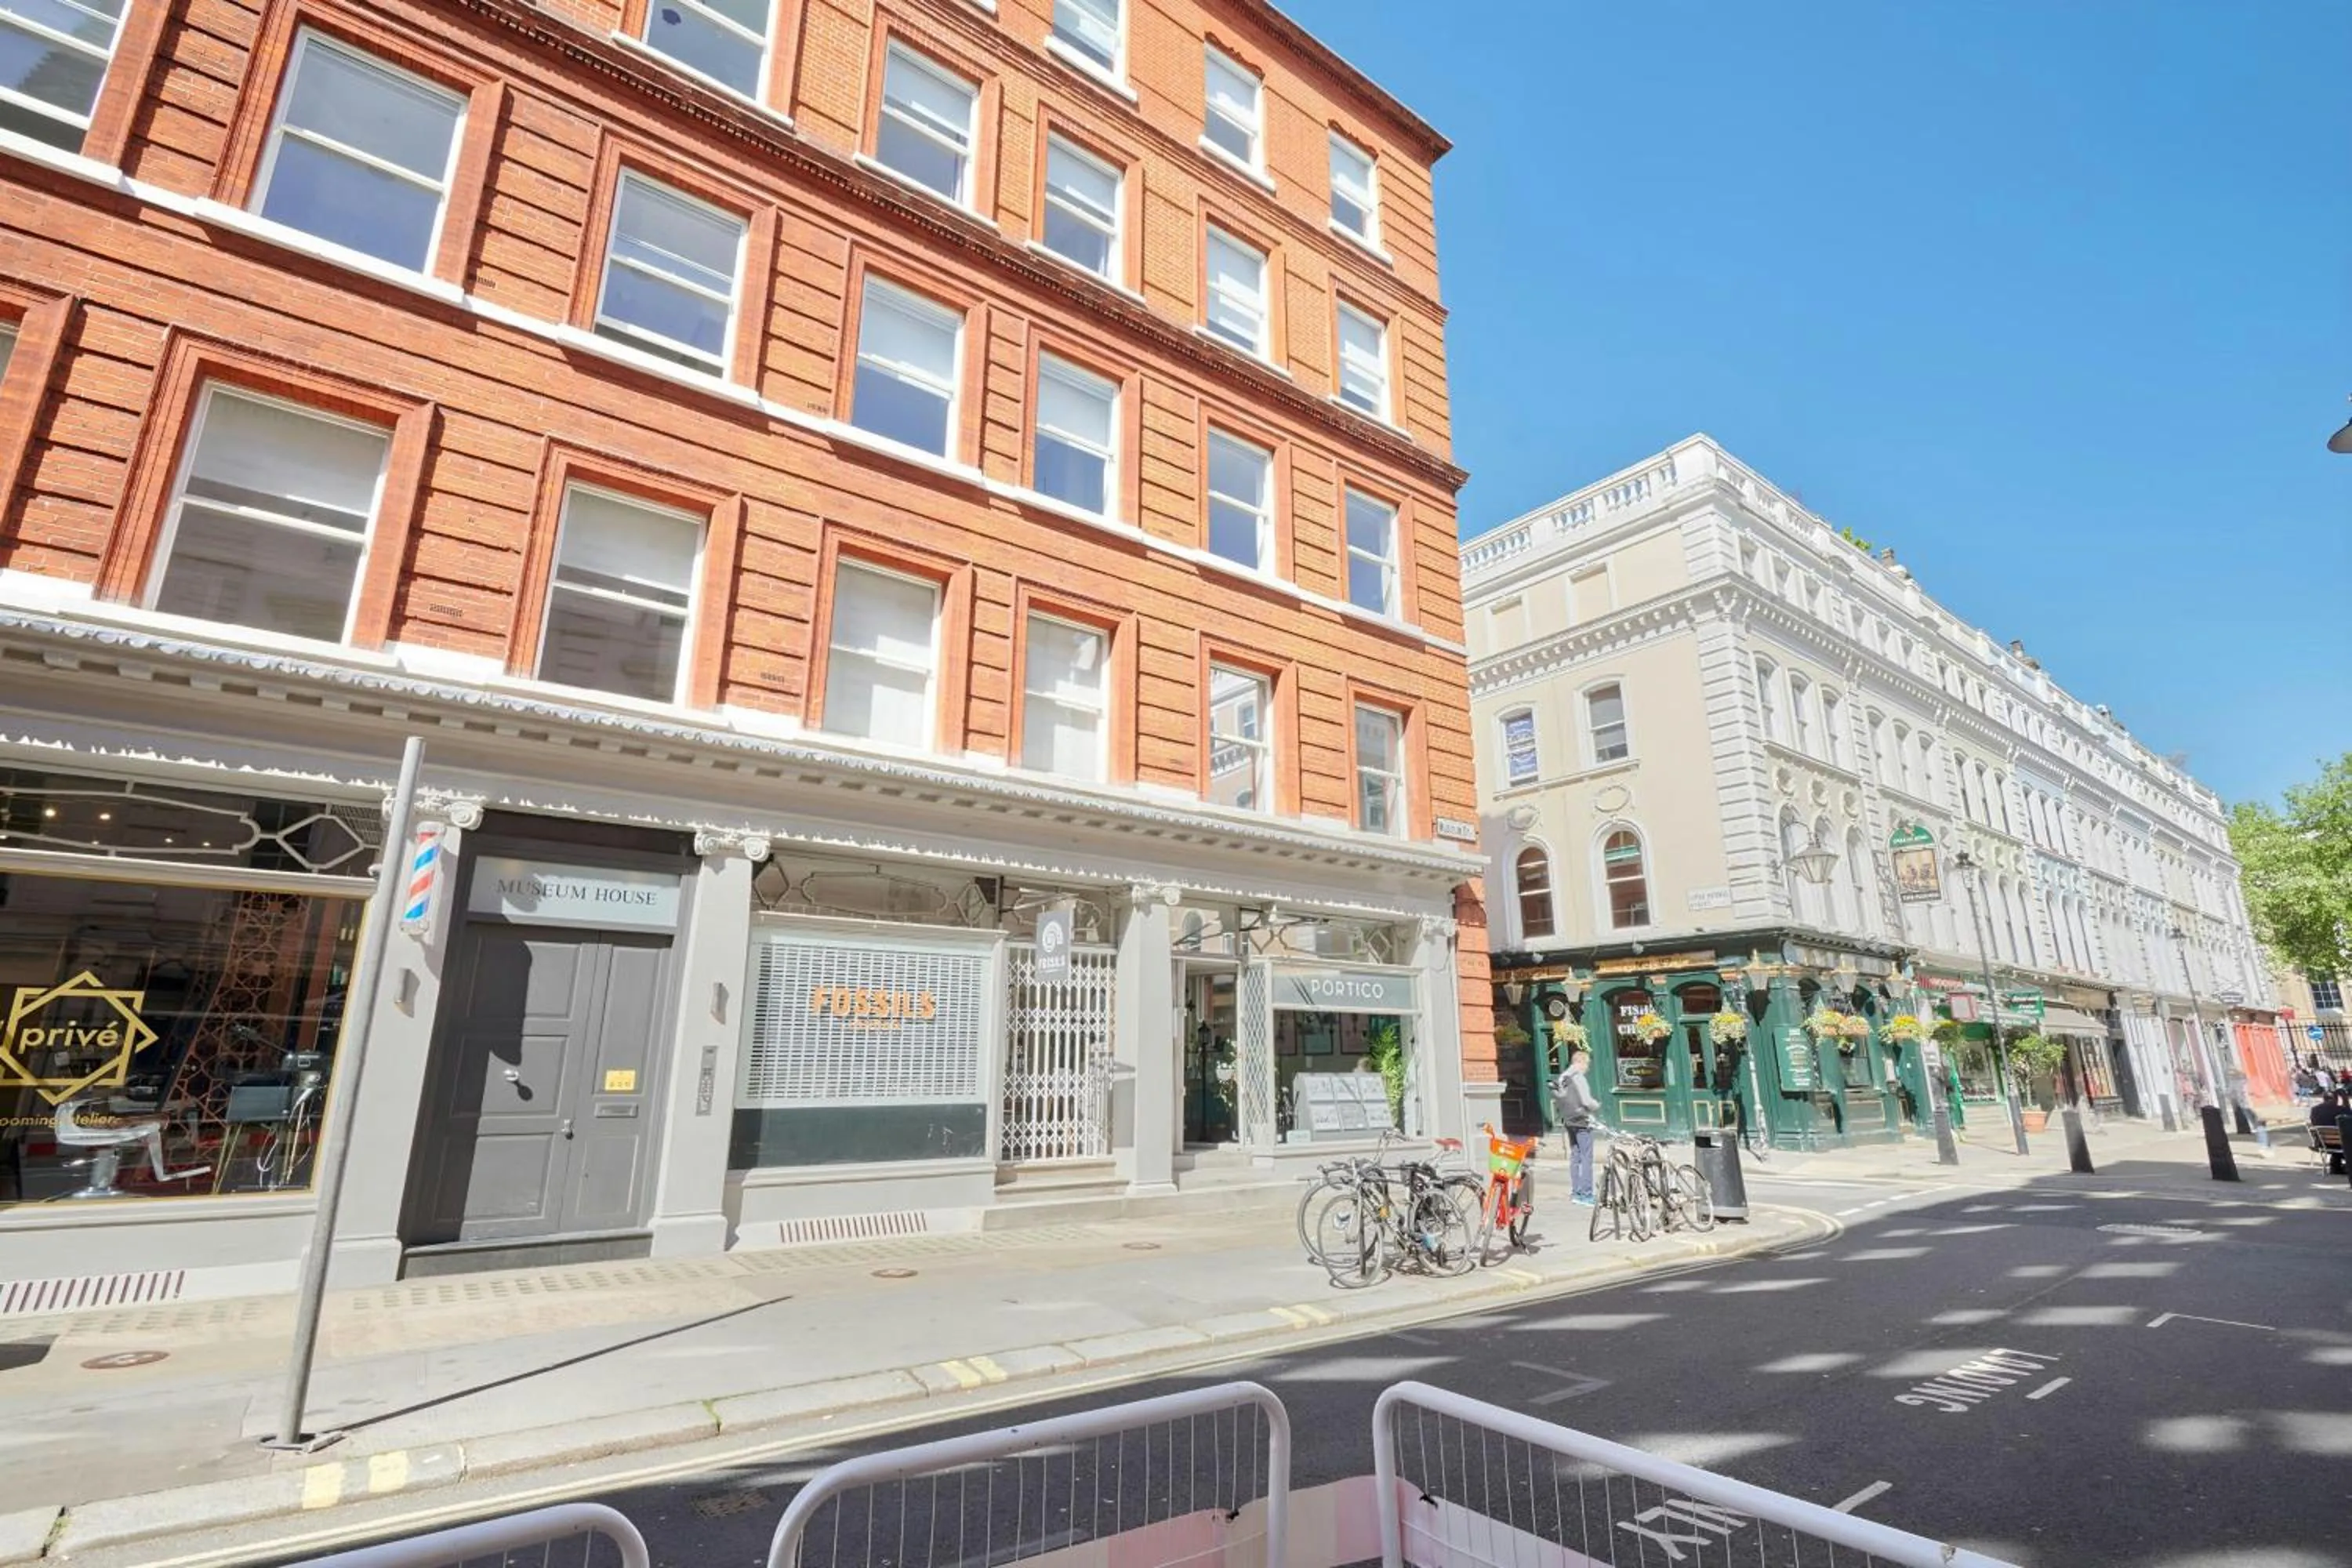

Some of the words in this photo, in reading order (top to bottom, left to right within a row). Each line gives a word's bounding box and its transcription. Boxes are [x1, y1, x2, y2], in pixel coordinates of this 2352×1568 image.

[496, 879, 586, 901] MUSEUM
[594, 887, 658, 906] HOUSE
[811, 985, 936, 1020] FOSSILS
[1311, 979, 1385, 999] PORTICO
[17, 1020, 119, 1054] privé
[72, 1111, 116, 1125] telier
[1893, 1348, 2060, 1412] LOADING
[1617, 1498, 1759, 1561] NLY
